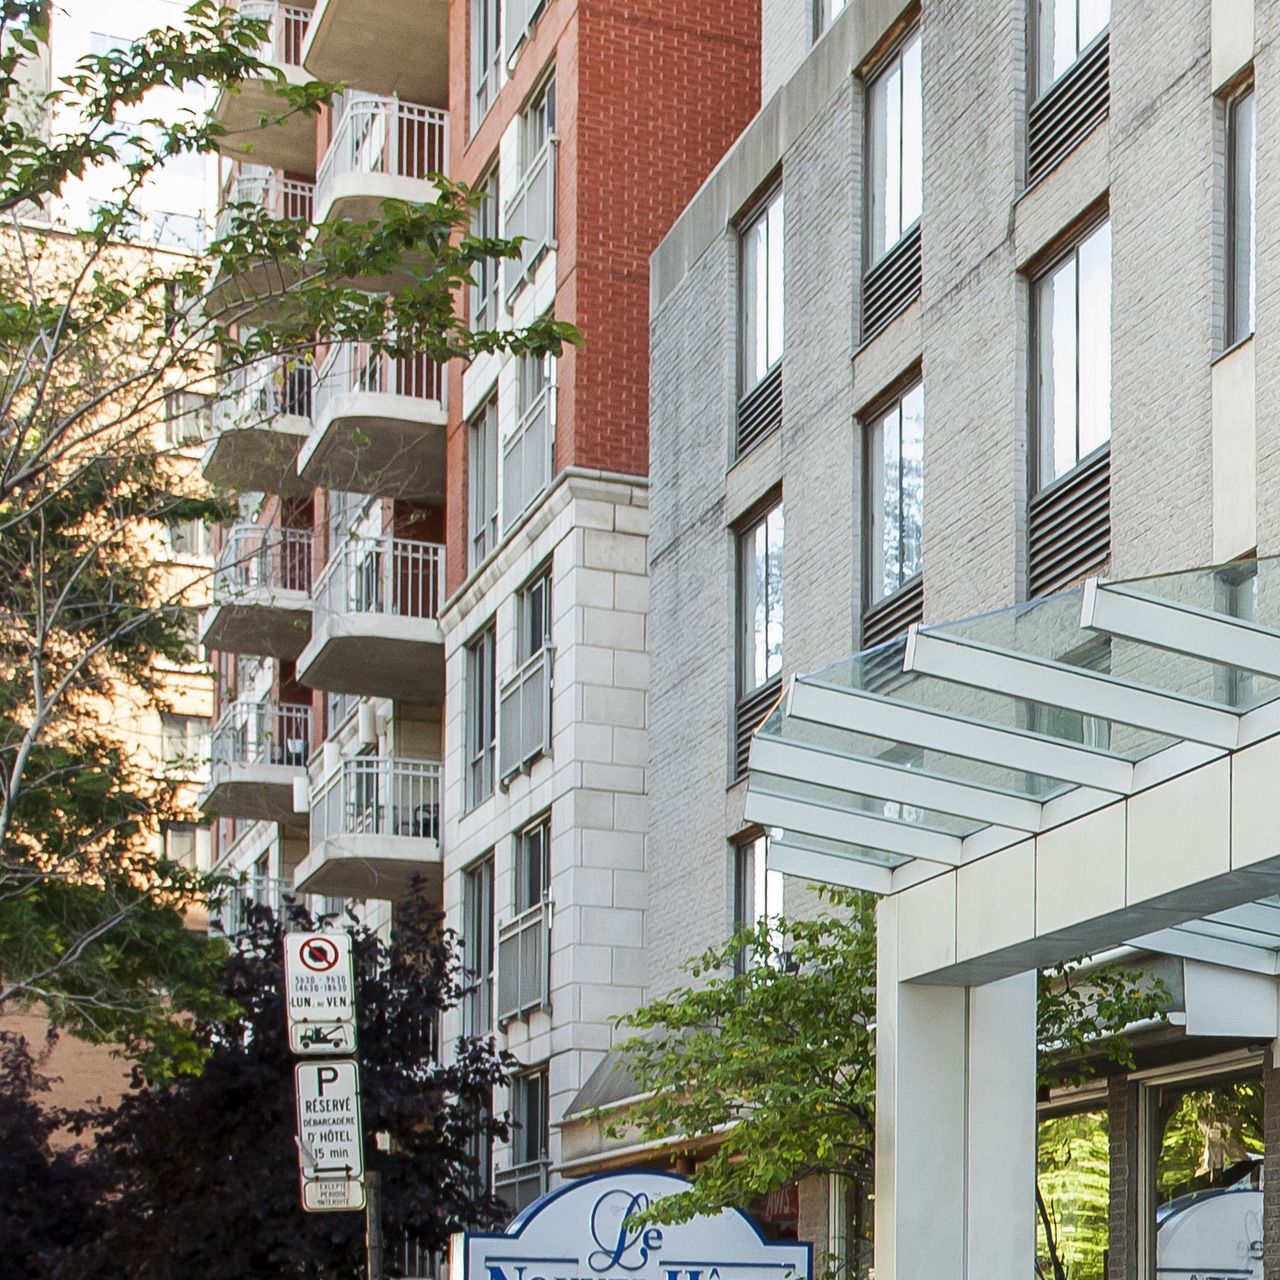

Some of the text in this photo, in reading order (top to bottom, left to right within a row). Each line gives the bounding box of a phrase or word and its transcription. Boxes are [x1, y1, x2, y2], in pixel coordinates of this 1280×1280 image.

[317, 1066, 339, 1097] P
[305, 1096, 351, 1113] RÉSERVÉ
[314, 1147, 349, 1159] 15 min
[588, 1189, 663, 1271] Le
